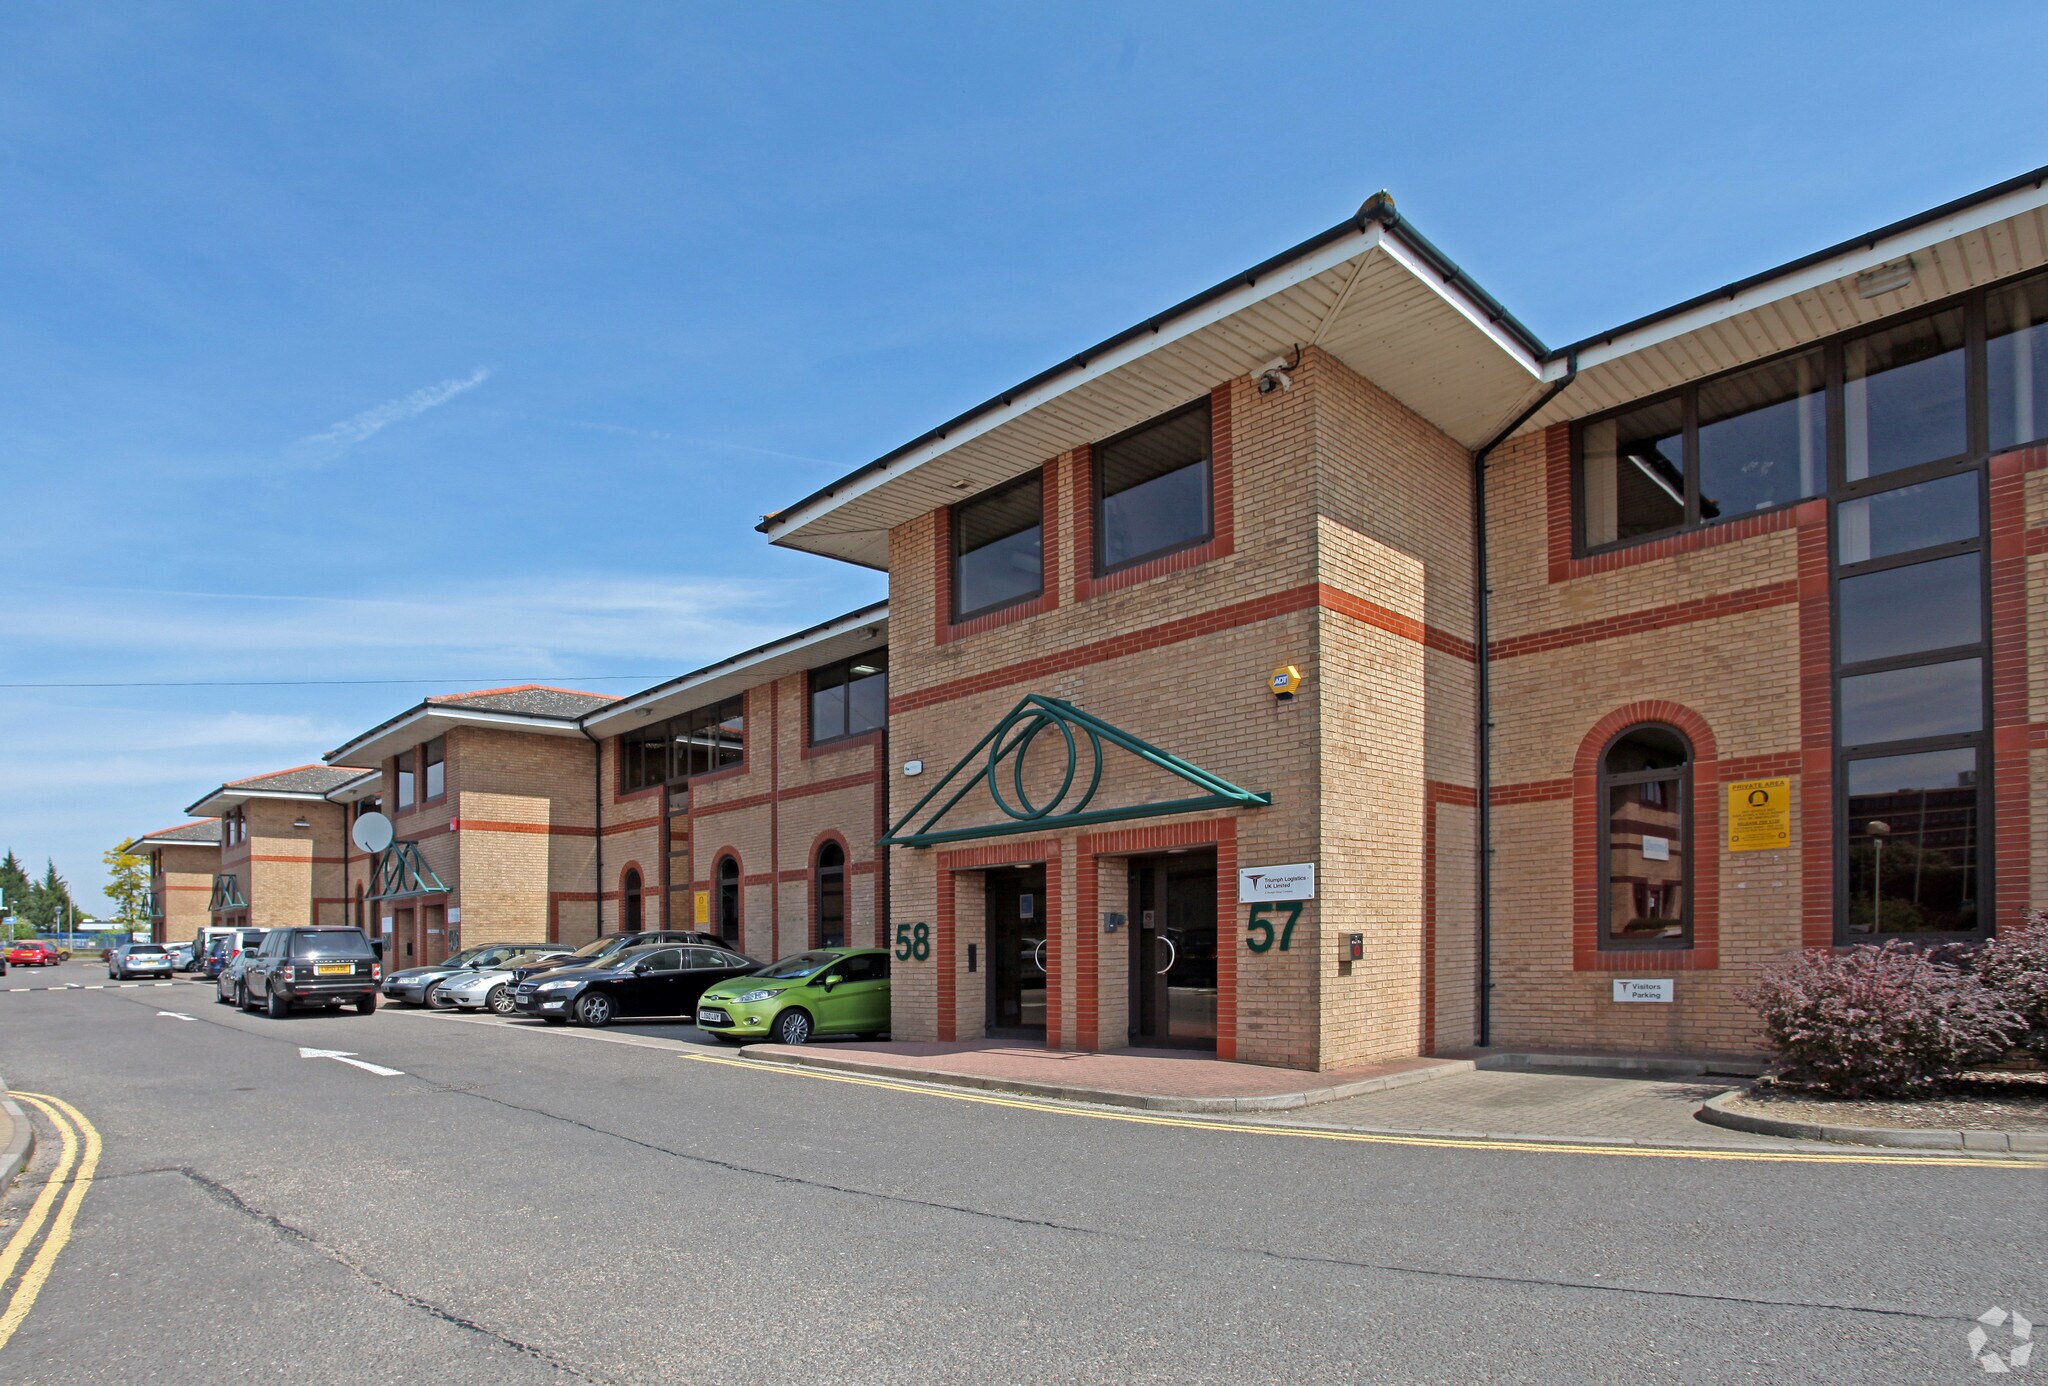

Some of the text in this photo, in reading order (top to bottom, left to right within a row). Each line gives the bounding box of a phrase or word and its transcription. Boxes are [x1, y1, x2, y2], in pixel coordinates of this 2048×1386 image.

[1274, 674, 1288, 685] ADT
[1246, 902, 1304, 953] 57
[895, 922, 929, 961] 58
[1632, 991, 1661, 999] Parking
